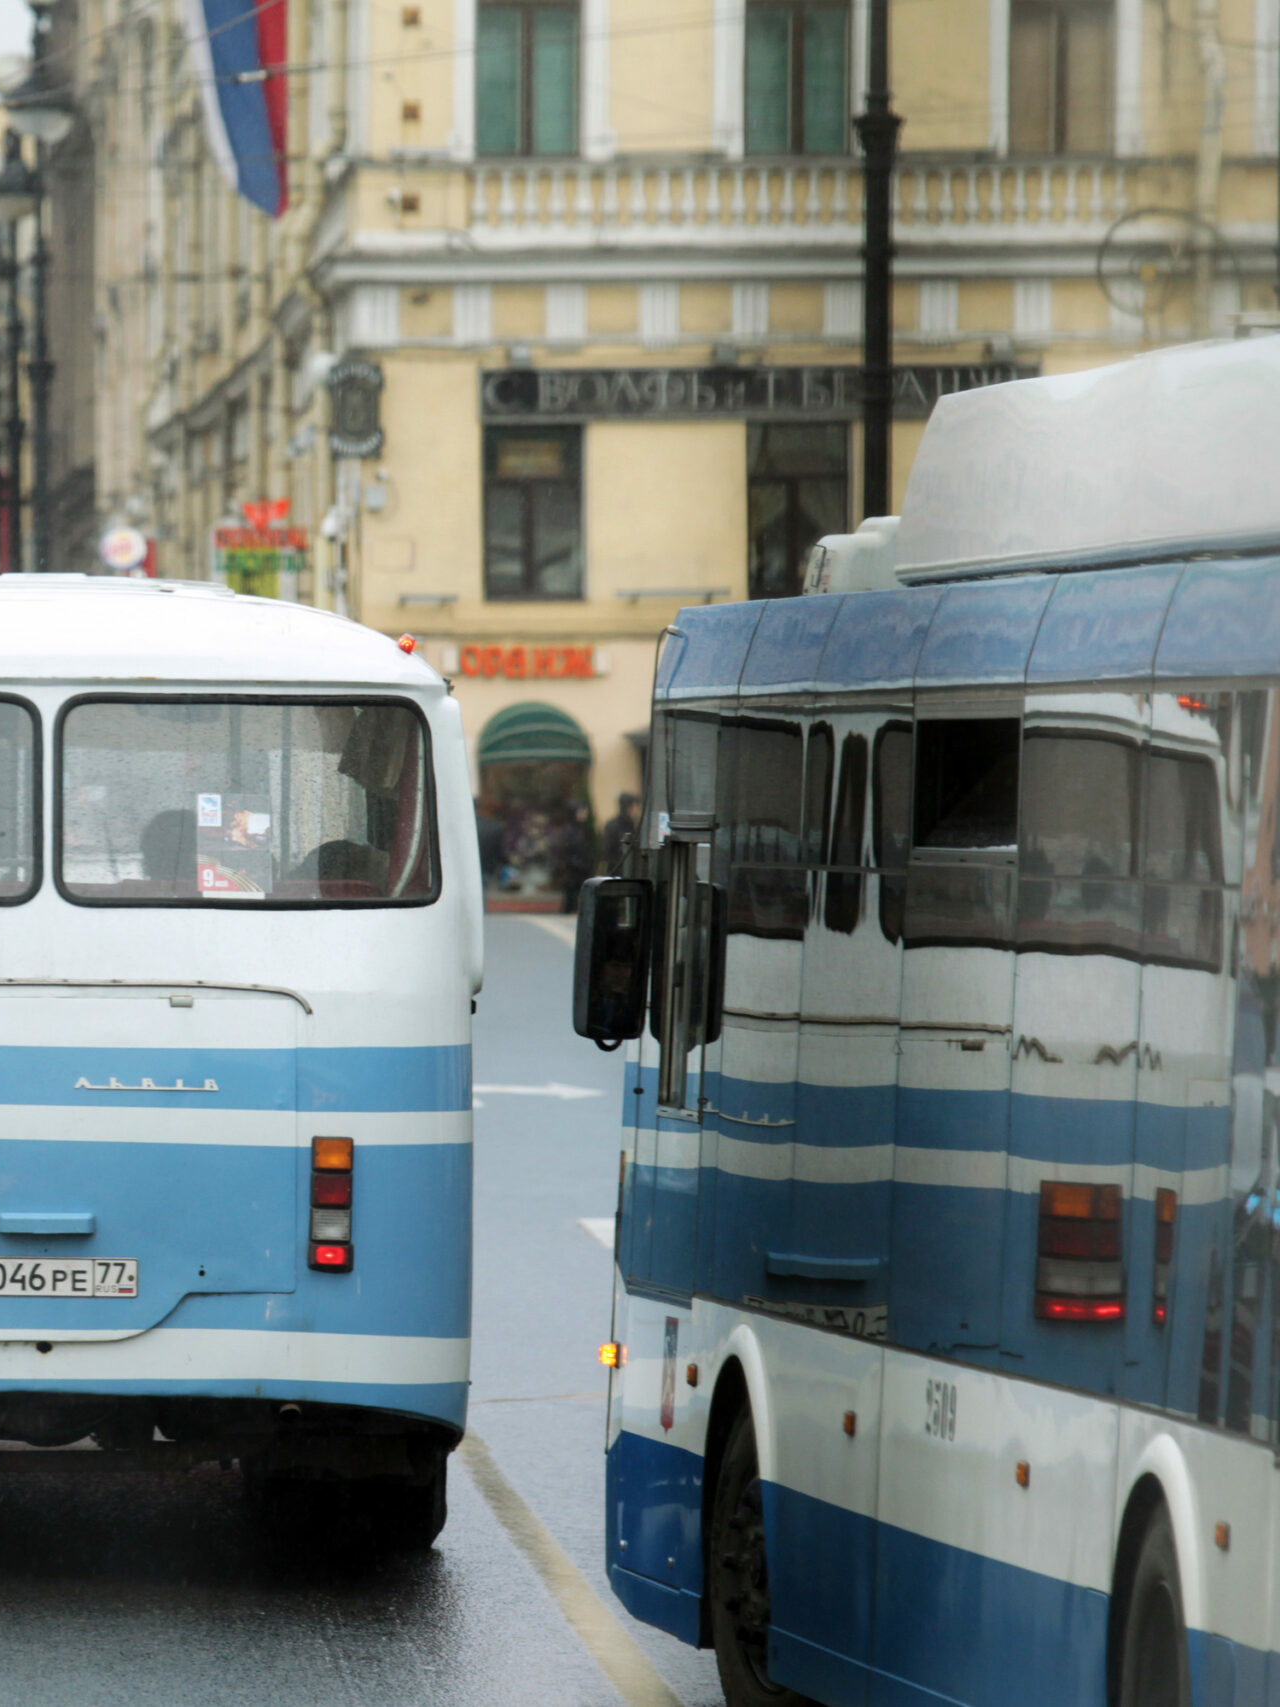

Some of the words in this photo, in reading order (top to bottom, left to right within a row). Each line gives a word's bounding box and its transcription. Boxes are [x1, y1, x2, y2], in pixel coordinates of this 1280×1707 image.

[202, 868, 214, 888] 9
[96, 1262, 127, 1284] 77
[95, 1285, 118, 1293] RUS
